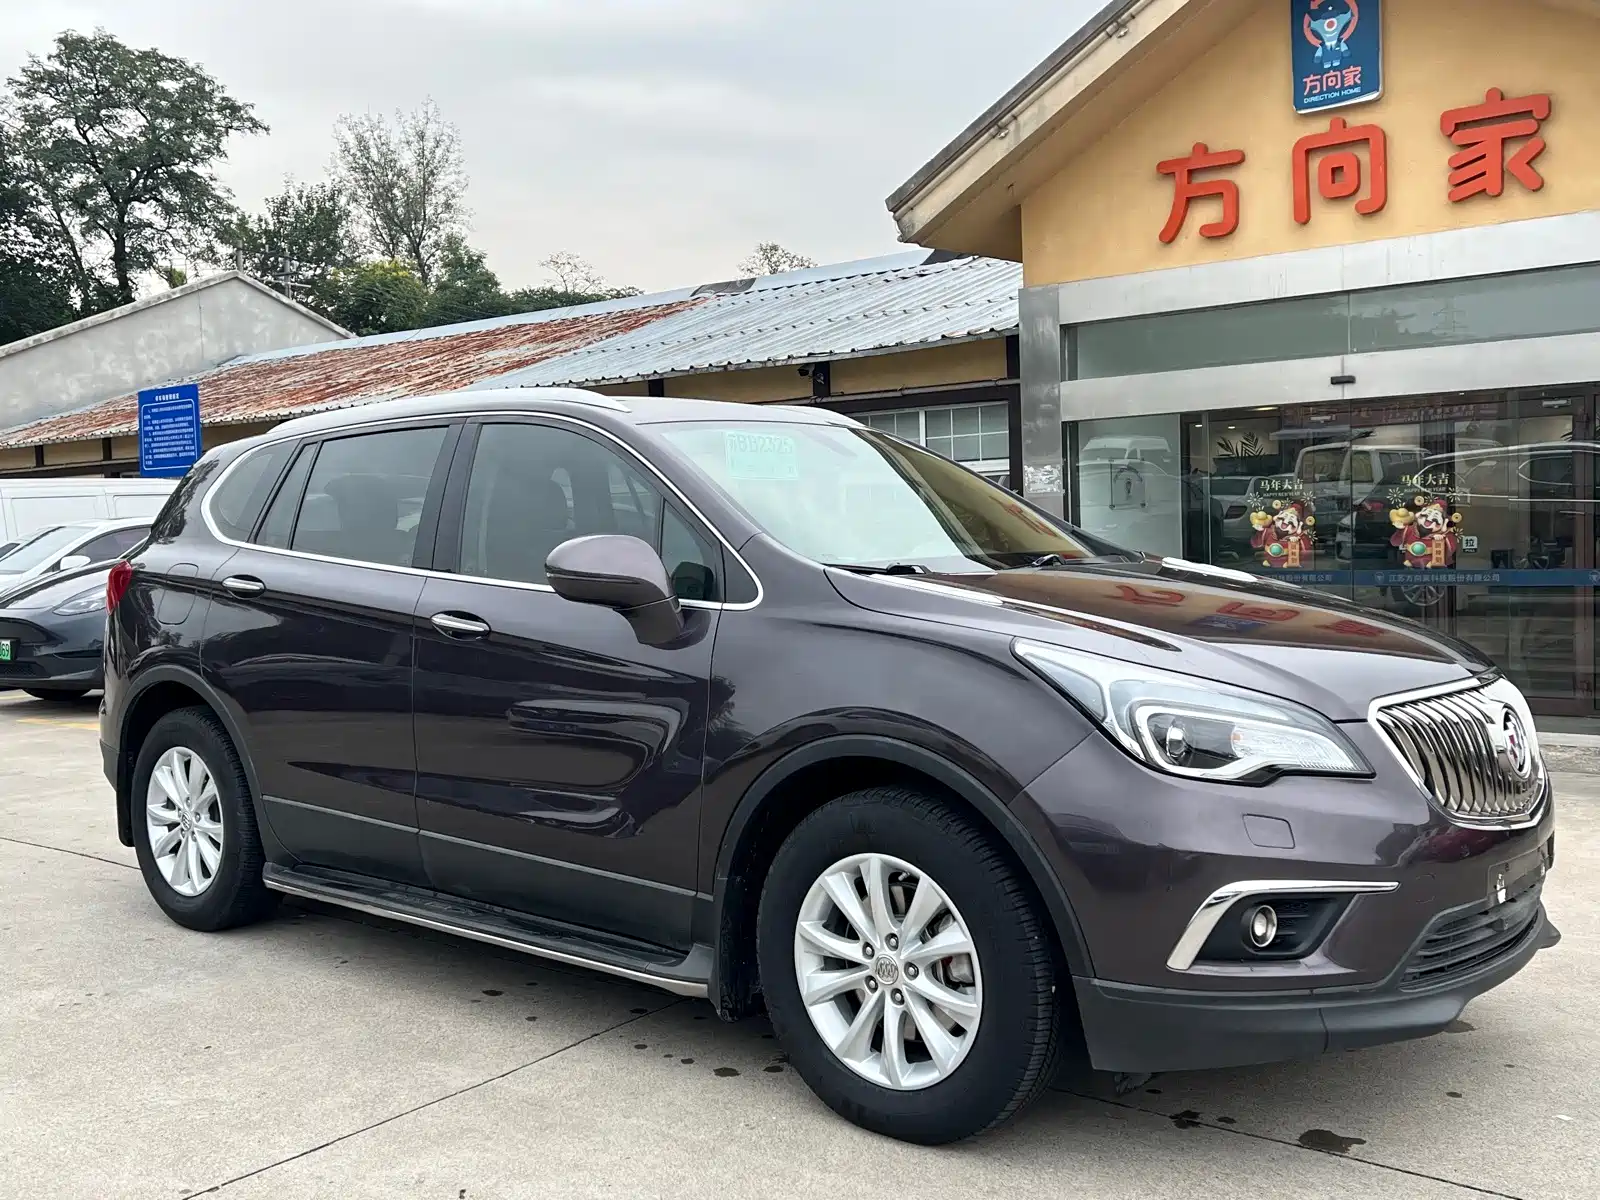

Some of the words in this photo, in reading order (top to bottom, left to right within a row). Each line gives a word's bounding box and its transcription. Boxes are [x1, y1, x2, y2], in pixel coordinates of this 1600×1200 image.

[1303, 65, 1361, 96] 方向家
[1304, 91, 1340, 103] DIRECTION
[1341, 87, 1361, 96] HOME
[1157, 87, 1551, 244] 方向家
[1259, 479, 1303, 491] 马年大吉
[1401, 473, 1450, 487] 马年大吉
[1465, 538, 1475, 548] 拉
[1389, 573, 1500, 583] 江苏方向家科技股份有限公司
